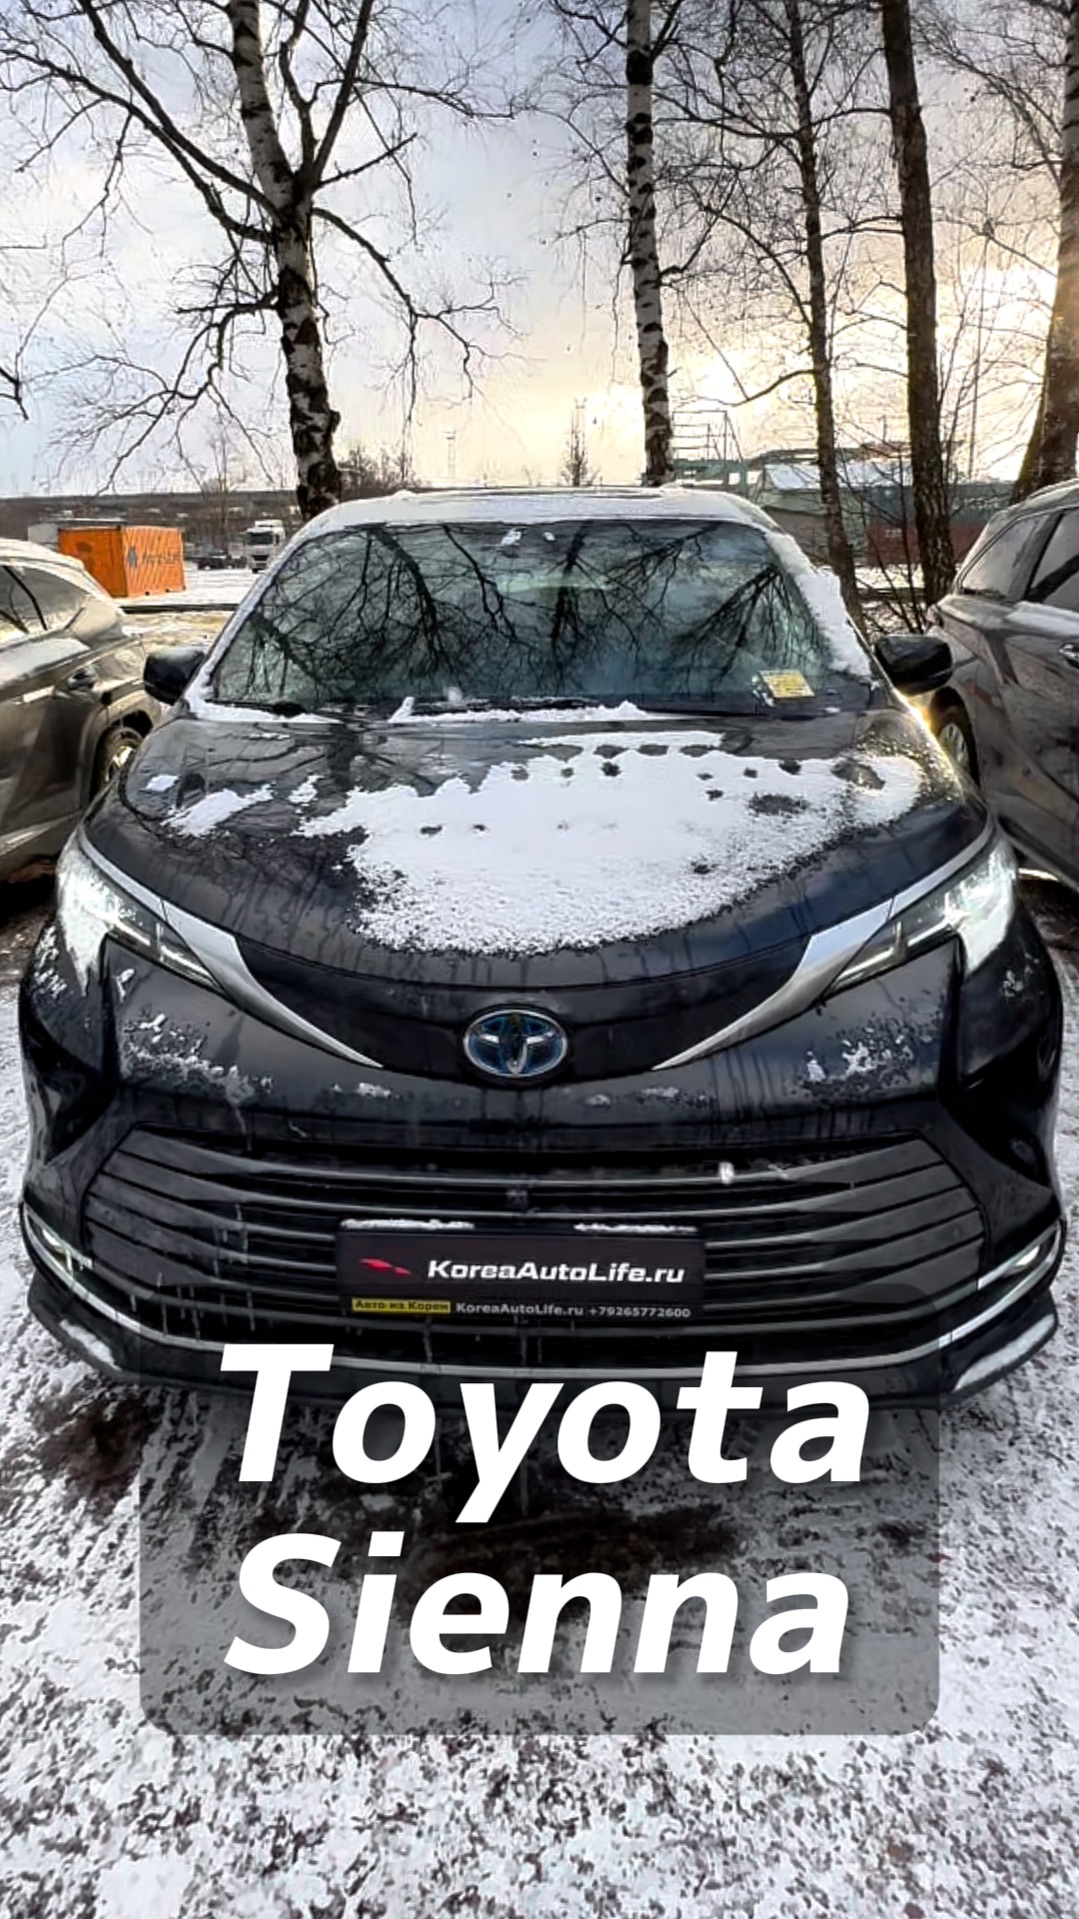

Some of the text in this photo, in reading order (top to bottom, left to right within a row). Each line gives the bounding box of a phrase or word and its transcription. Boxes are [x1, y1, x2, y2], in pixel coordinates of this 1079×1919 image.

[427, 1260, 685, 1283] KoreaAutoLife.ru
[355, 1300, 385, 1311] Авто
[389, 1301, 405, 1311] из
[456, 1303, 583, 1316] KoreaAutoLife.ru
[589, 1307, 691, 1318] +79265772600
